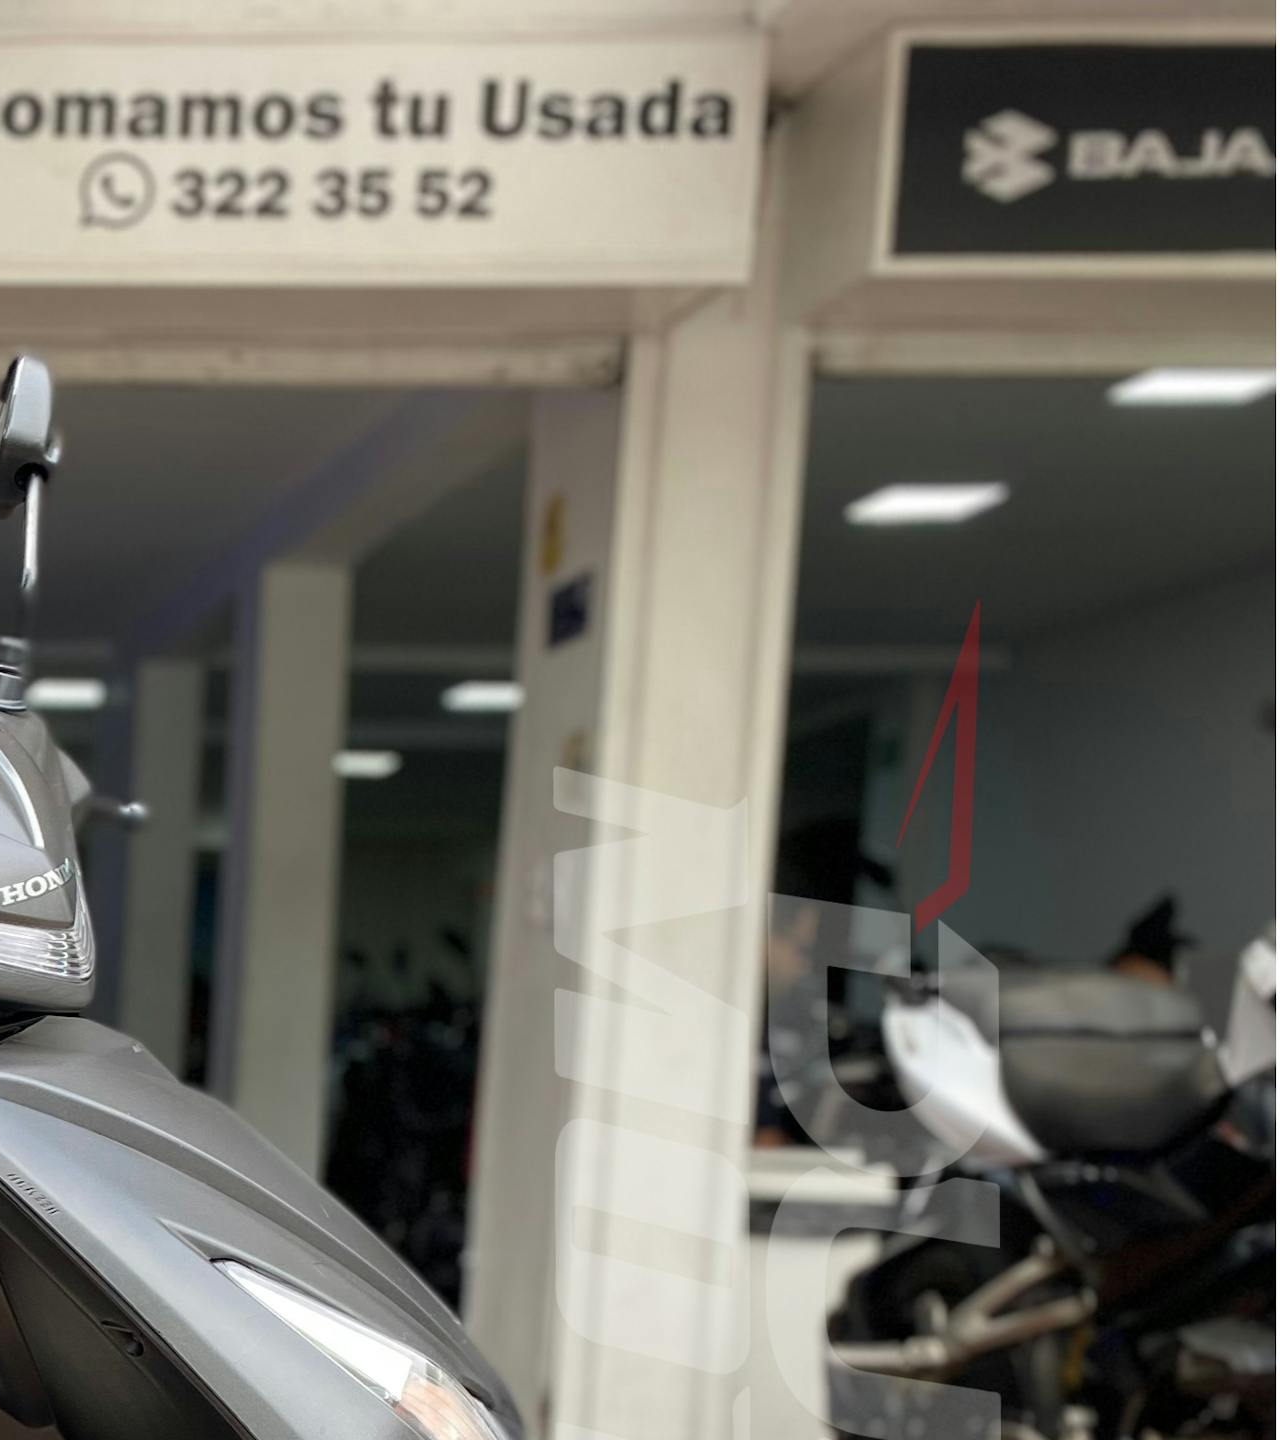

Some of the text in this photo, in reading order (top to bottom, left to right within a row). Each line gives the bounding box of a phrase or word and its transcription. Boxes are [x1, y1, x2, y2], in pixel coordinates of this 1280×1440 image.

[371, 80, 450, 139] tu
[480, 78, 735, 140] Usada
[1066, 127, 1275, 180] BAJA
[170, 168, 496, 219] 322 35 52
